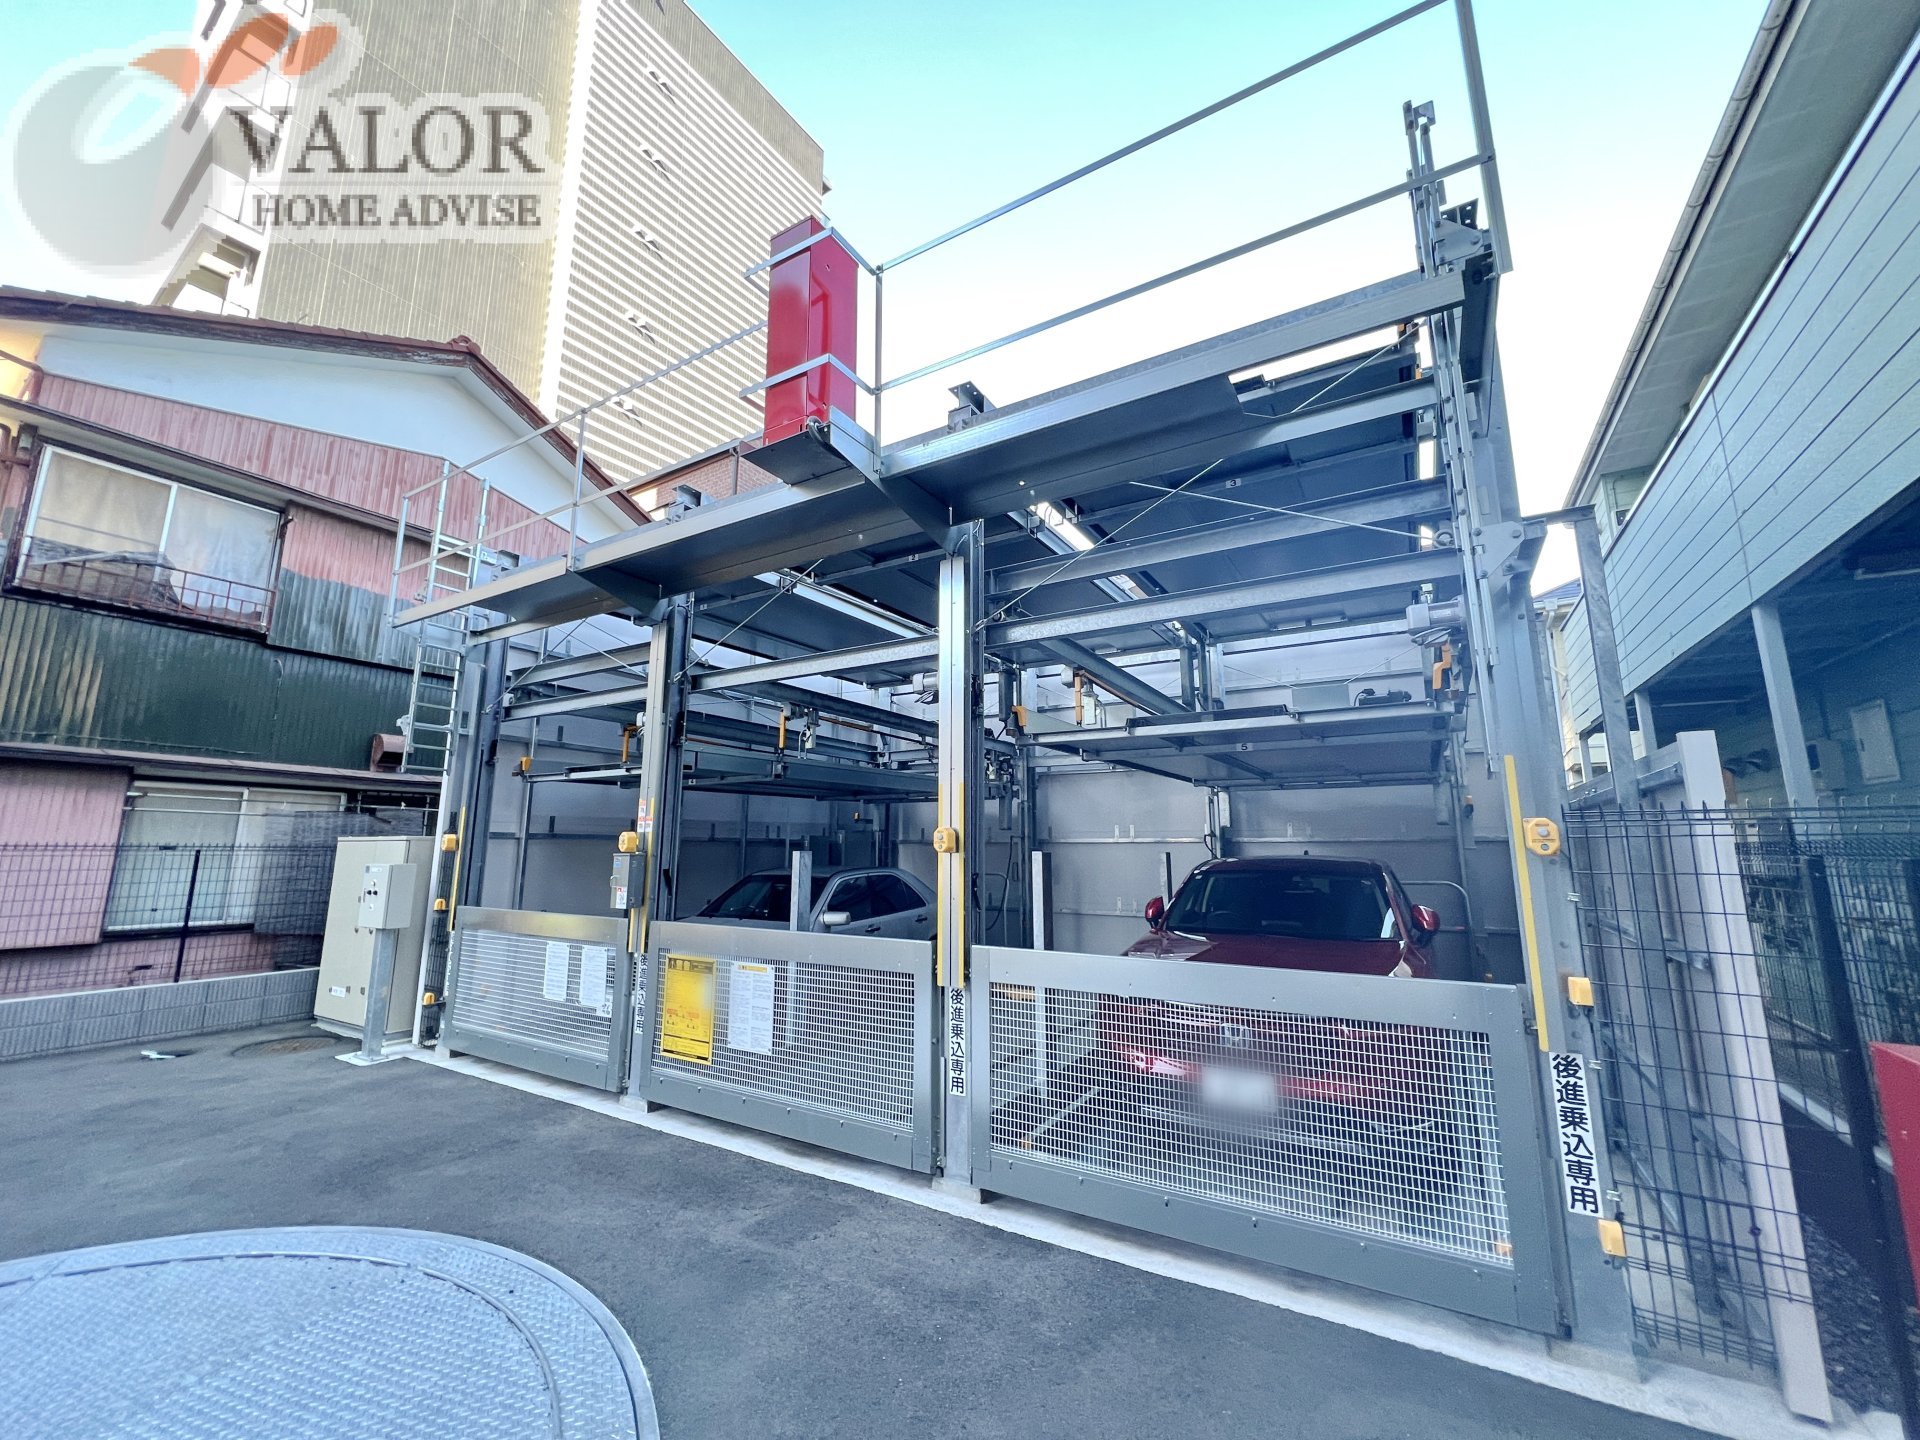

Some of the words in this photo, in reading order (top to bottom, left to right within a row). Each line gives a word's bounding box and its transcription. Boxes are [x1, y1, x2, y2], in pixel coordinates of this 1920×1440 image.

[950, 988, 965, 1095] 後進乗込専用
[1552, 1053, 1599, 1214] 後進乗込専用
